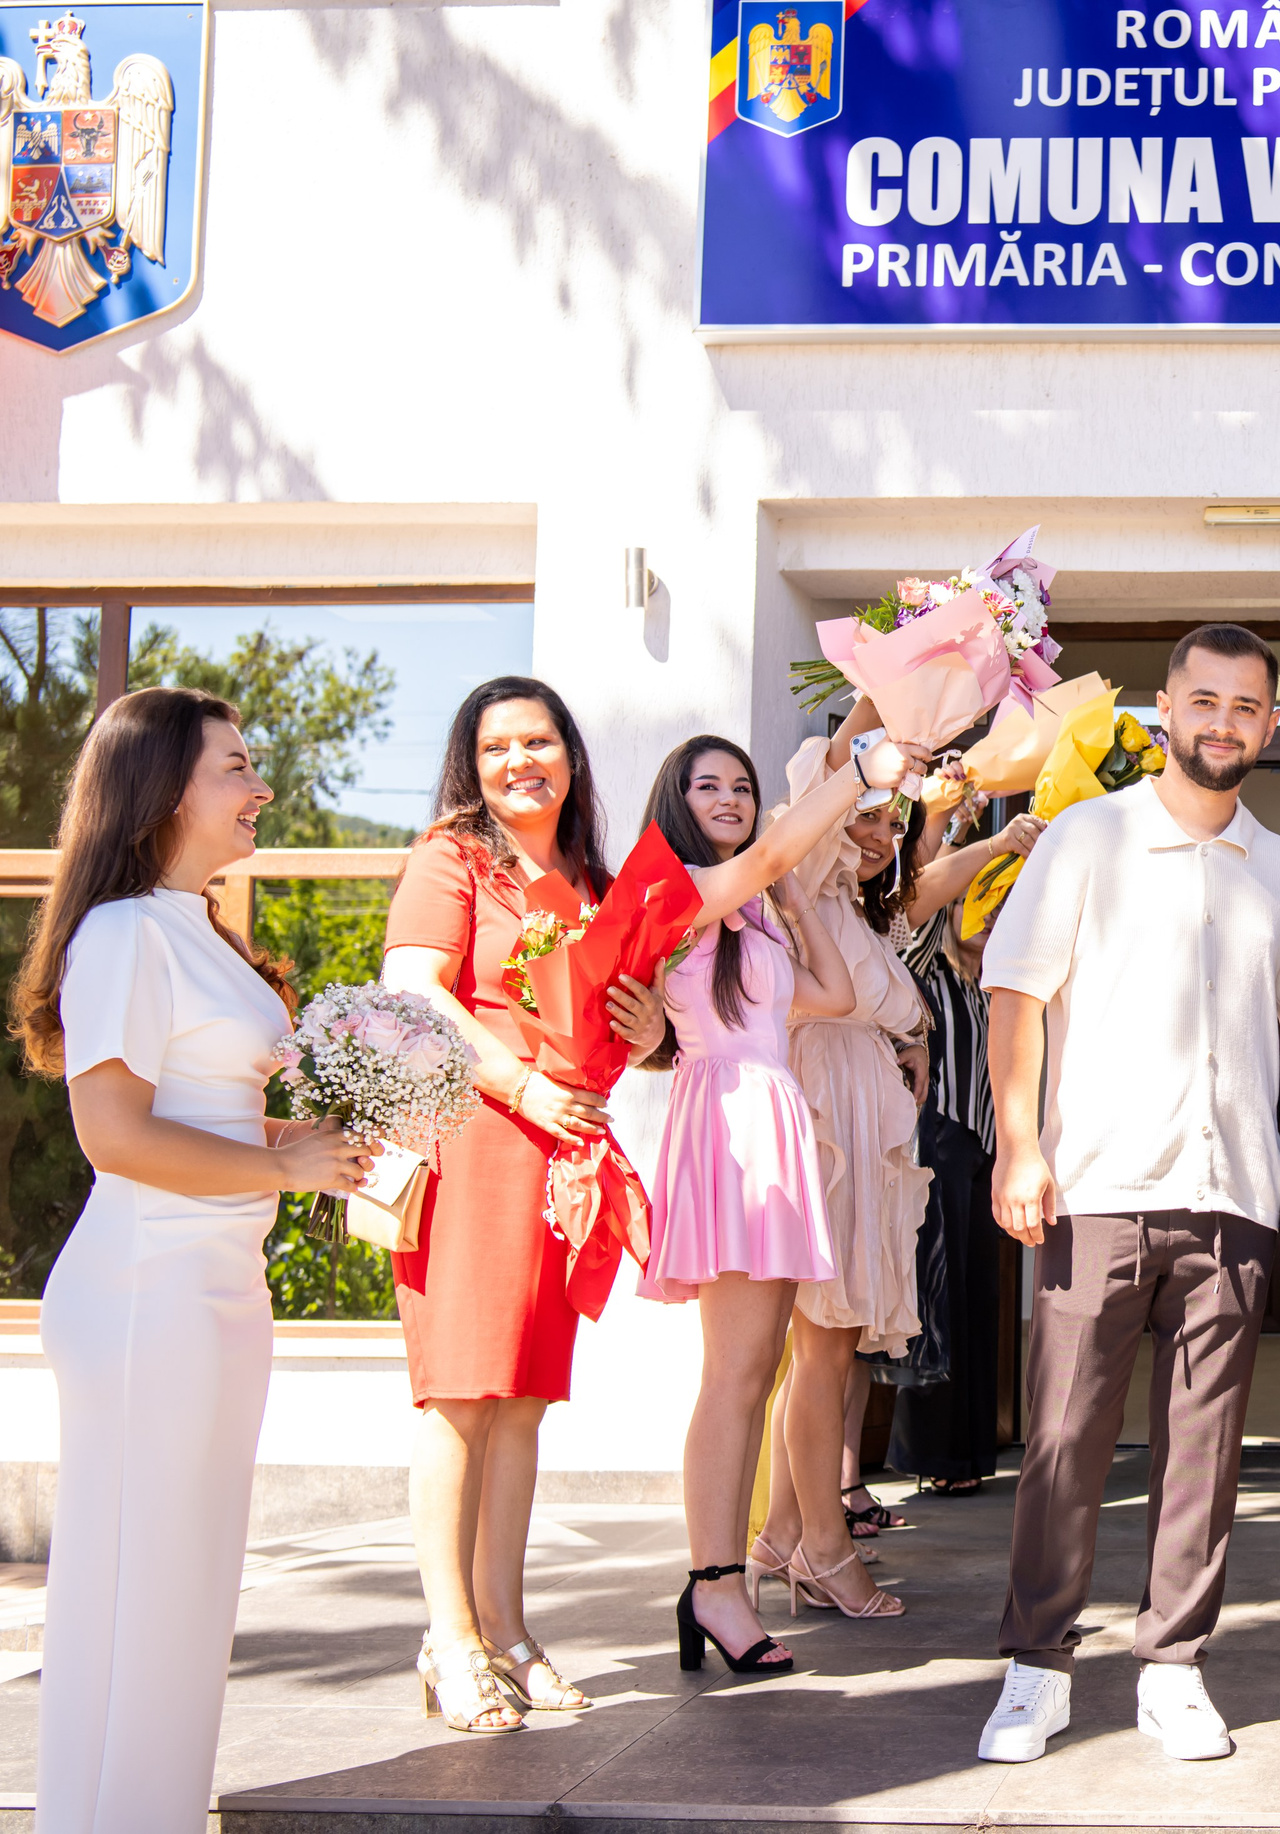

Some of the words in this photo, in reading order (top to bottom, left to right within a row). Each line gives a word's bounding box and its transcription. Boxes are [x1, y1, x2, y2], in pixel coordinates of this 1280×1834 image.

[1013, 66, 1238, 117] JUDEȚUL
[845, 136, 1224, 228] COMUNA
[841, 230, 1128, 288] PRIMĂRIA
[1143, 263, 1163, 274] -
